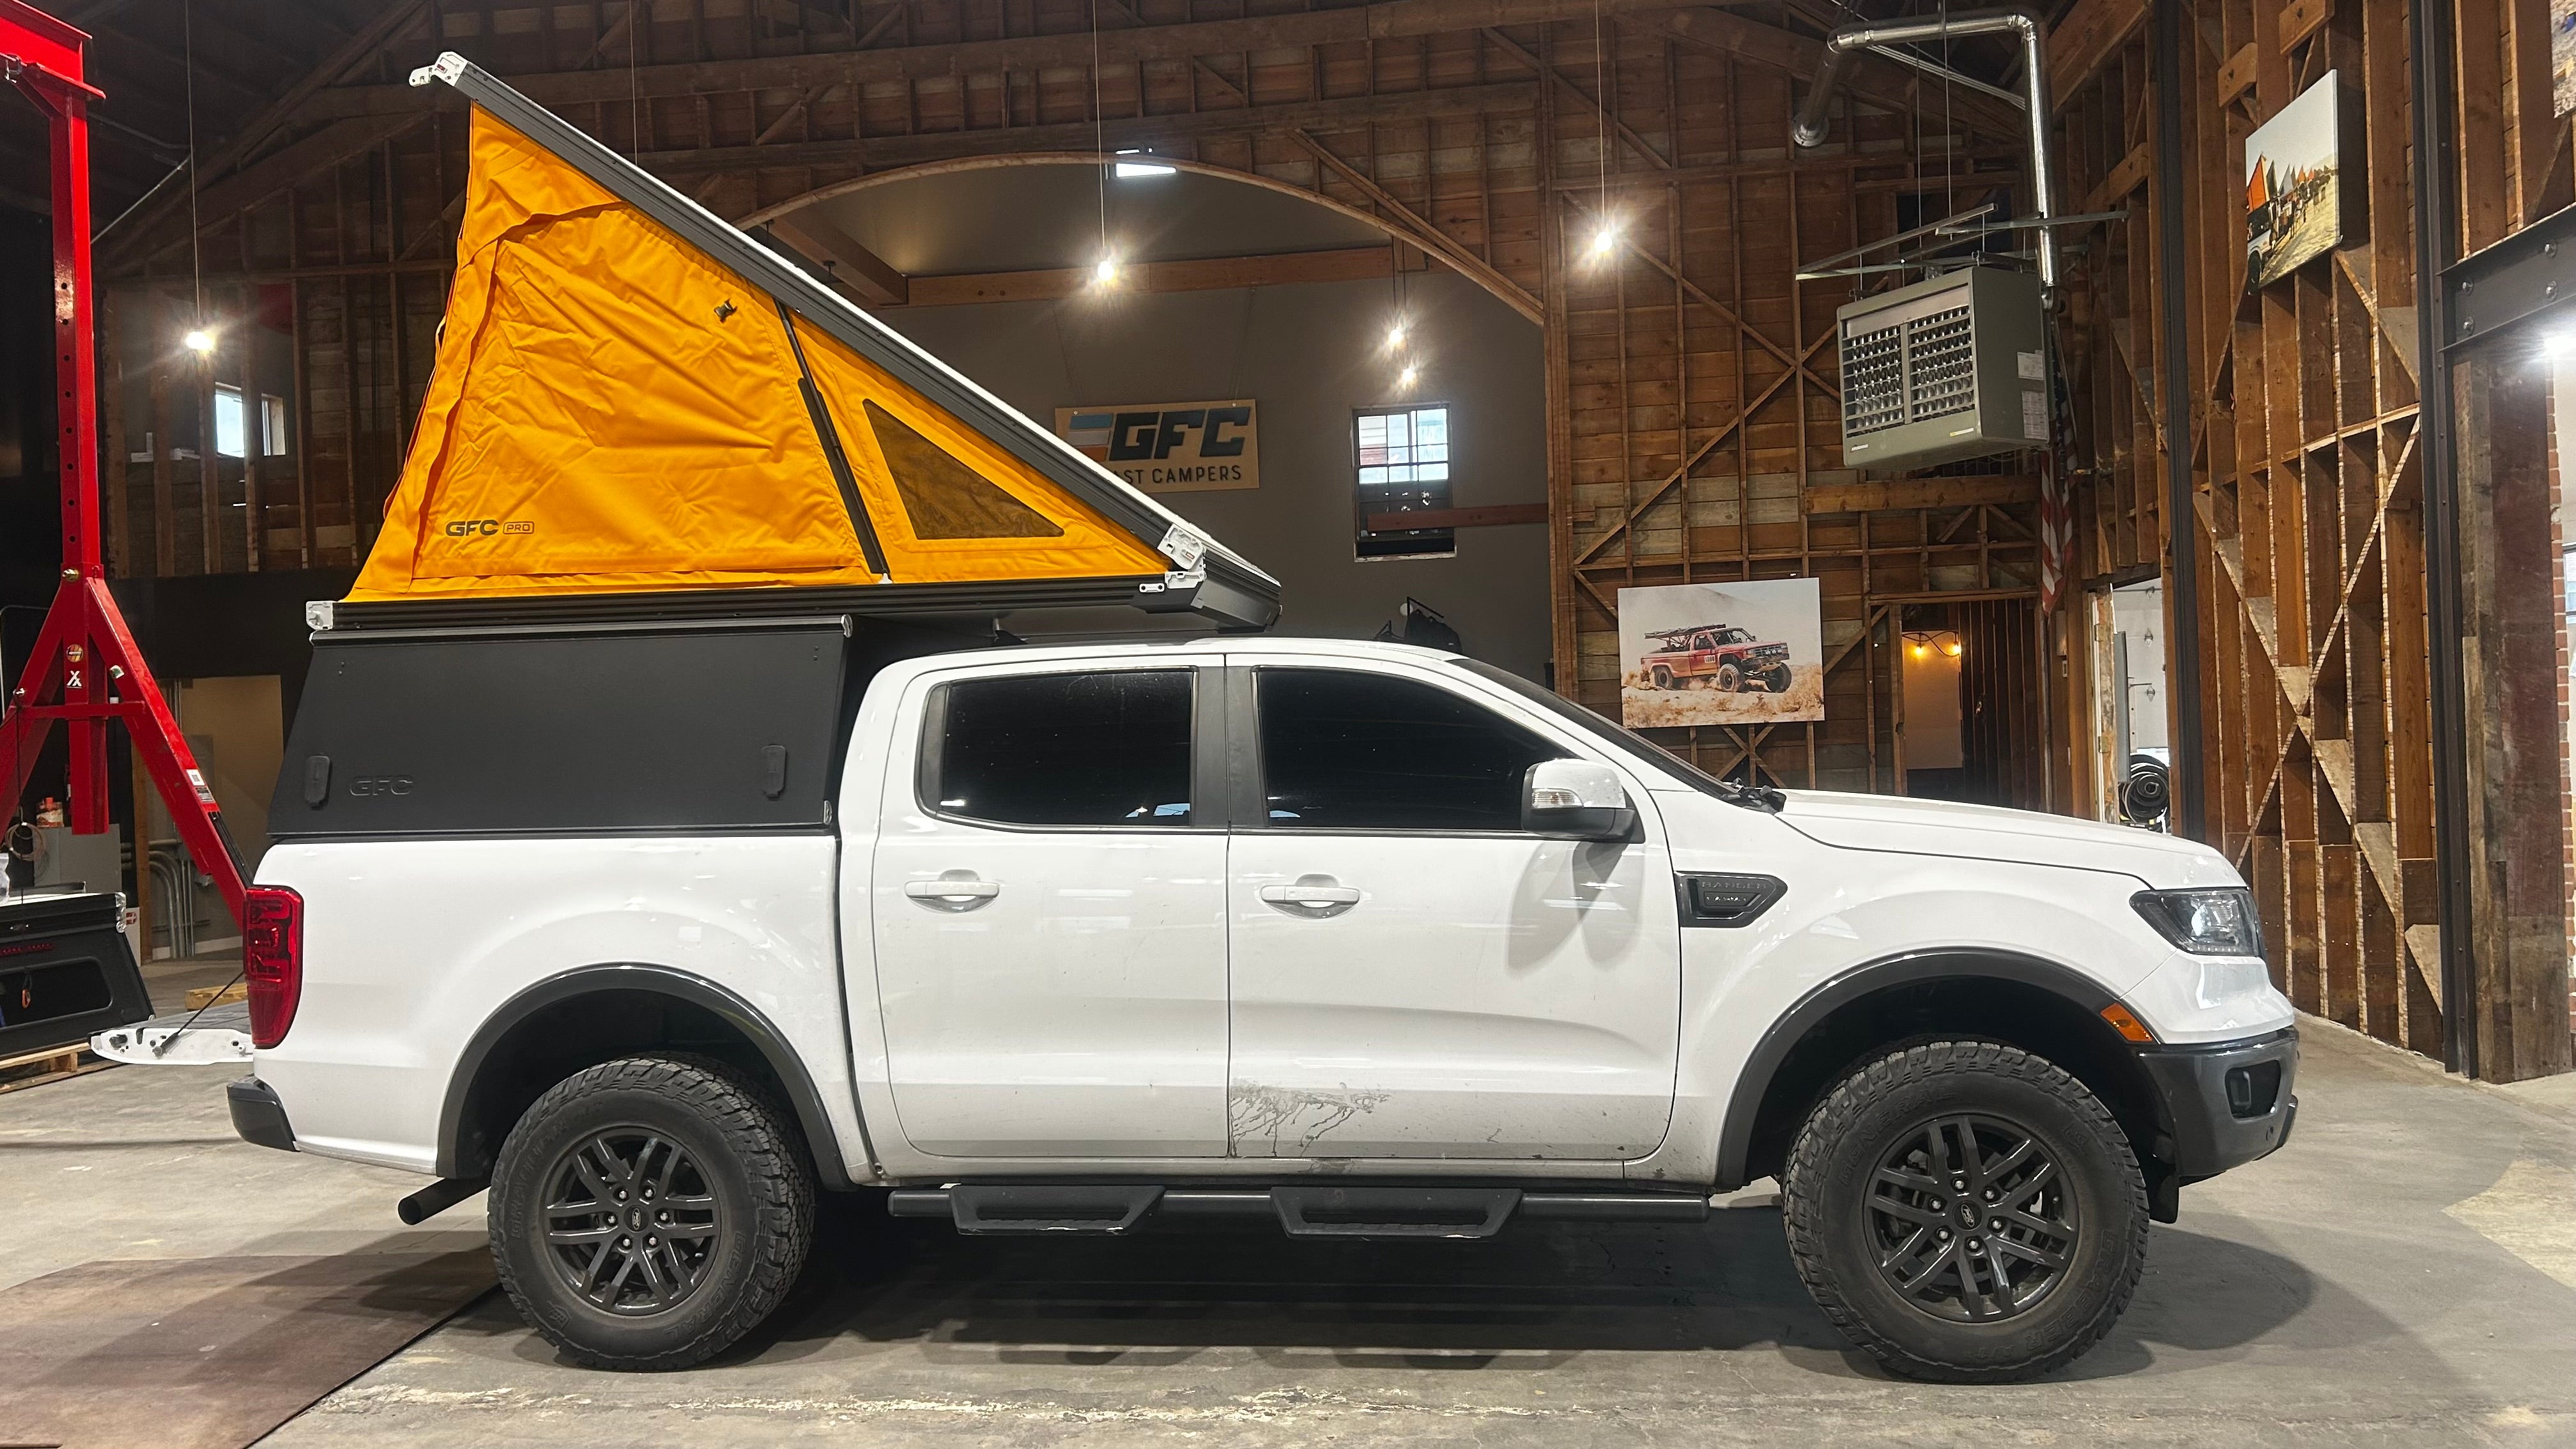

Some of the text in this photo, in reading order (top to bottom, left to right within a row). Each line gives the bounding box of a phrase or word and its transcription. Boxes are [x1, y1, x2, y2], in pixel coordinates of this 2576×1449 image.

[1109, 406, 1251, 461] GFC
[1151, 465, 1241, 484] CAMPERS
[446, 519, 498, 536] GFC
[349, 775, 414, 795] GFC
[664, 1230, 746, 1340] GENERAL
[2025, 1229, 2118, 1351] GRABBER
